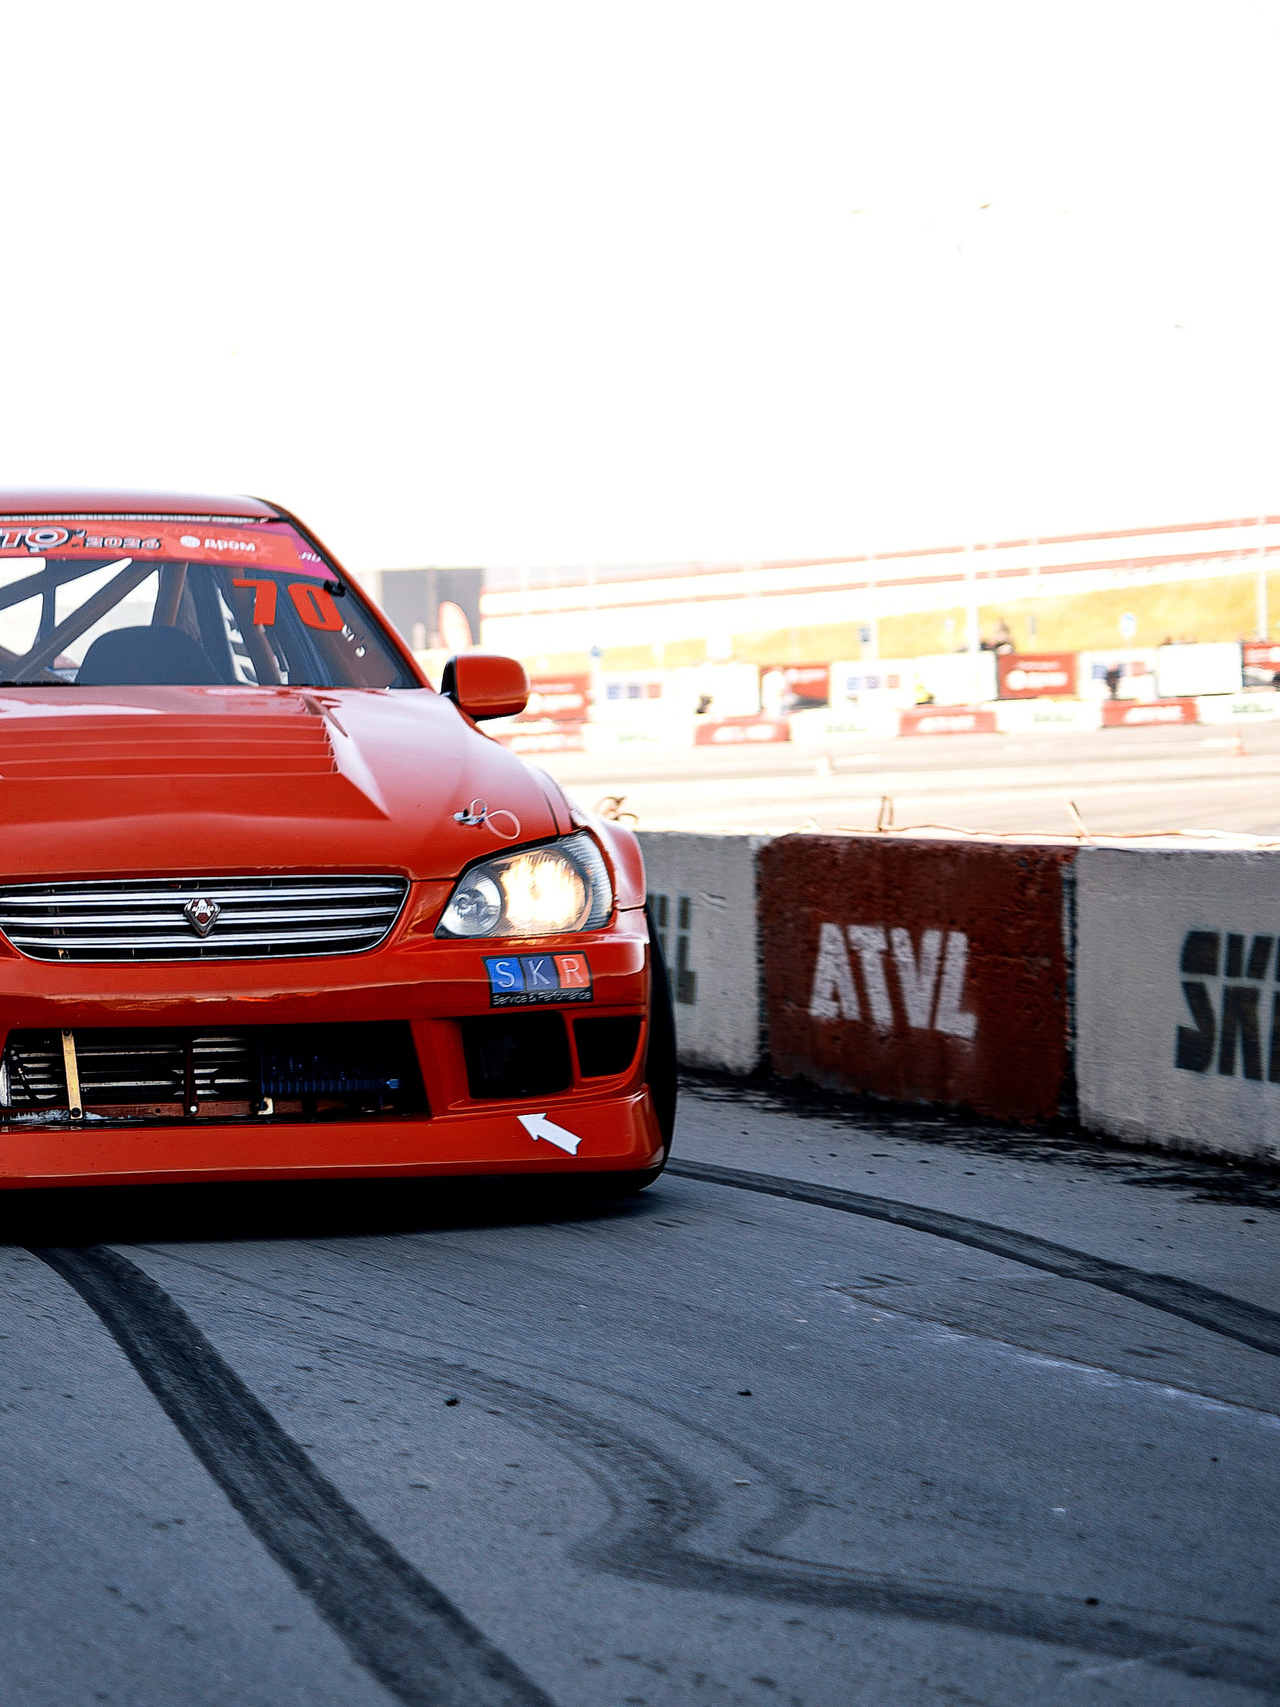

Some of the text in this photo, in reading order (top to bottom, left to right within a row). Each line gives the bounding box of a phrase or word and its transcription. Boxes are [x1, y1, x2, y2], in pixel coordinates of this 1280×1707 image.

[232, 578, 345, 632] 70
[495, 957, 584, 988] SKR
[809, 922, 978, 1039] ATVL
